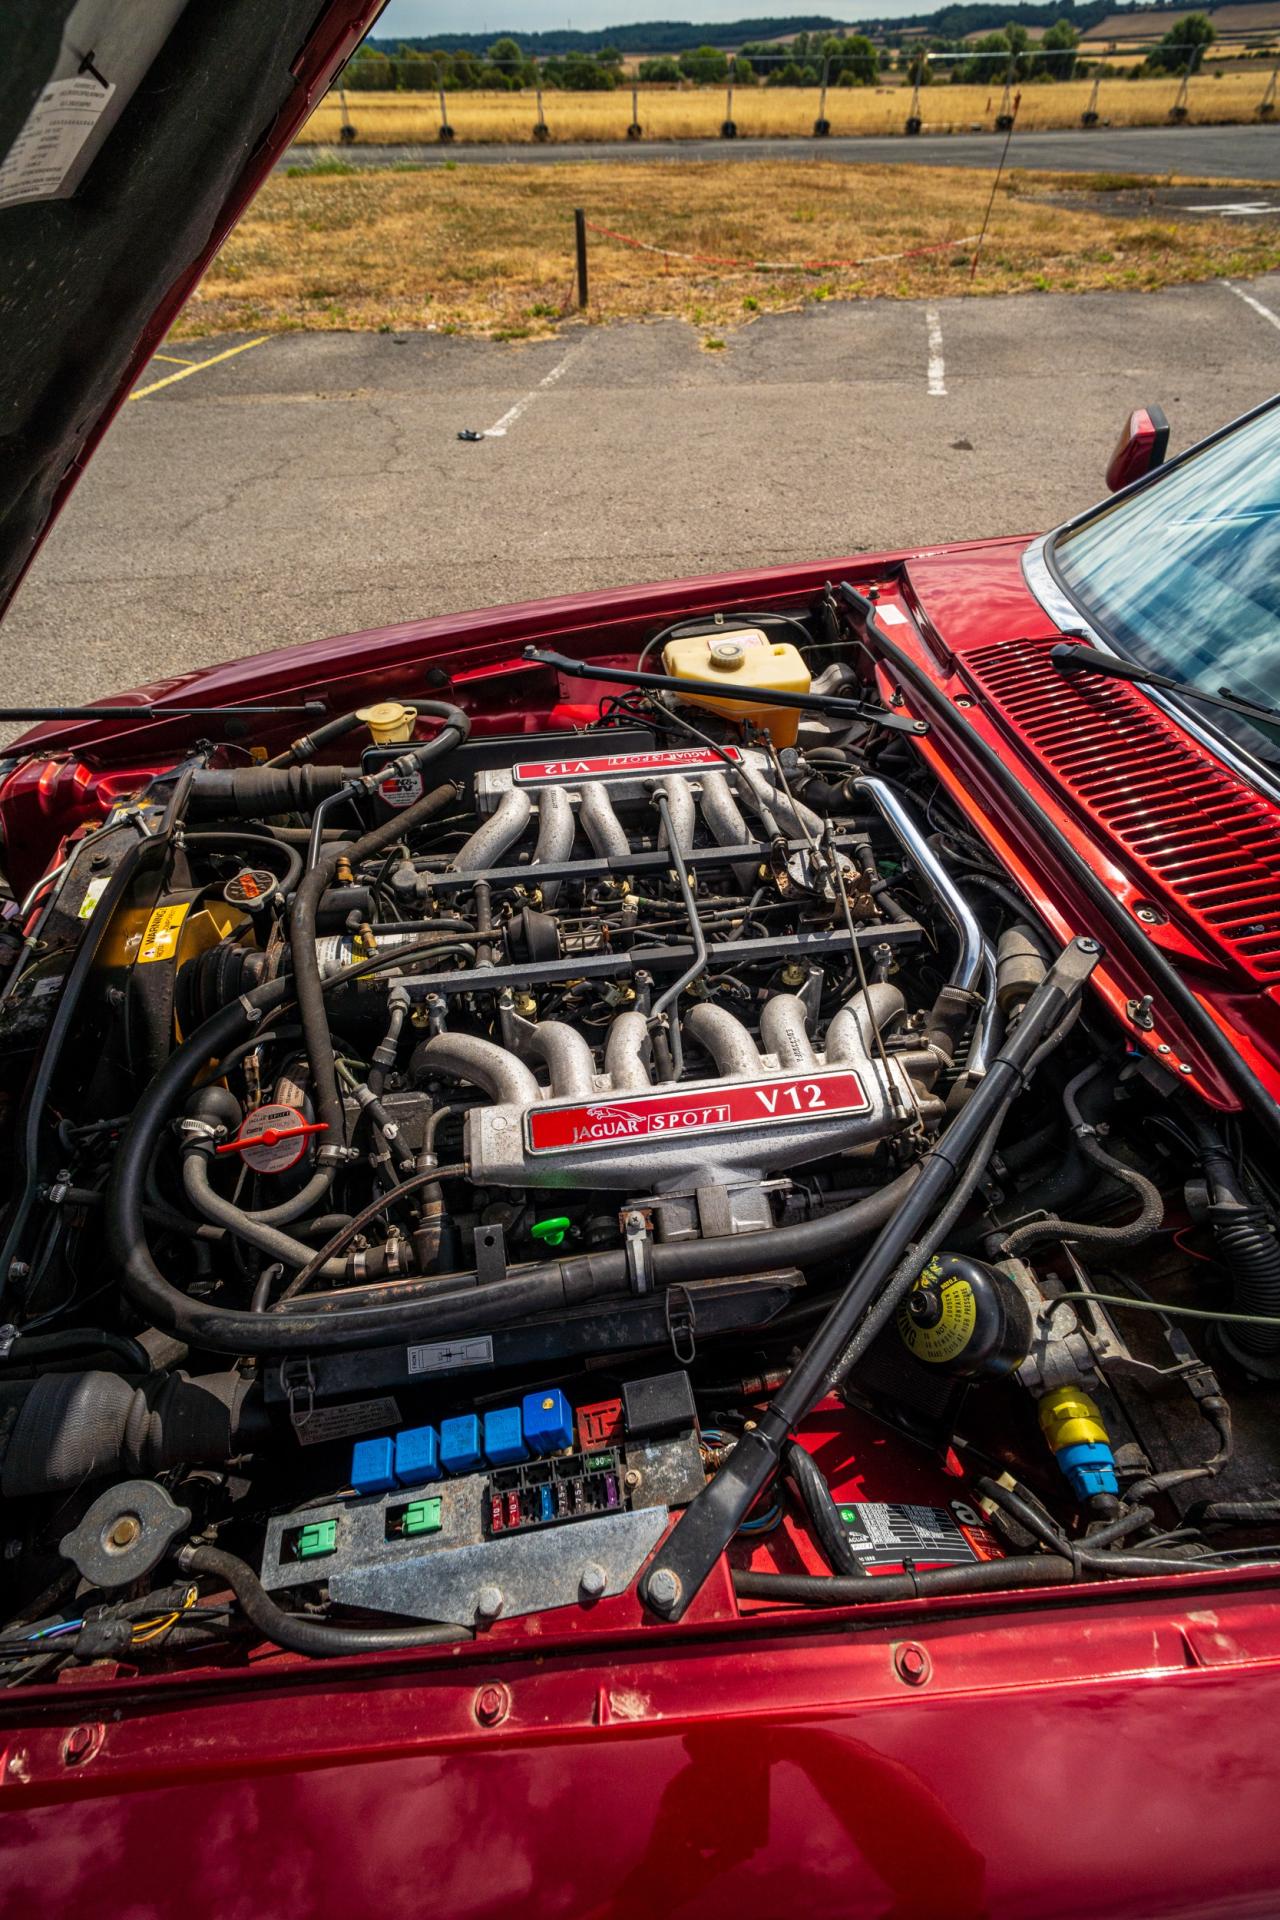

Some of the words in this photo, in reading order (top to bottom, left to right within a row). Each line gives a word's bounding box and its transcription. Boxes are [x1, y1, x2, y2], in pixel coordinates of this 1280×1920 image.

[667, 750, 711, 760] JAGUAR
[544, 761, 590, 775] V12
[572, 1120, 639, 1144] JAGUAR
[755, 1083, 826, 1113] V12
[936, 1323, 948, 1335] NOT
[945, 1294, 953, 1318] LOOSEN
[595, 1456, 605, 1466] 30
[493, 1507, 500, 1517] 10
[510, 1504, 517, 1513] 10
